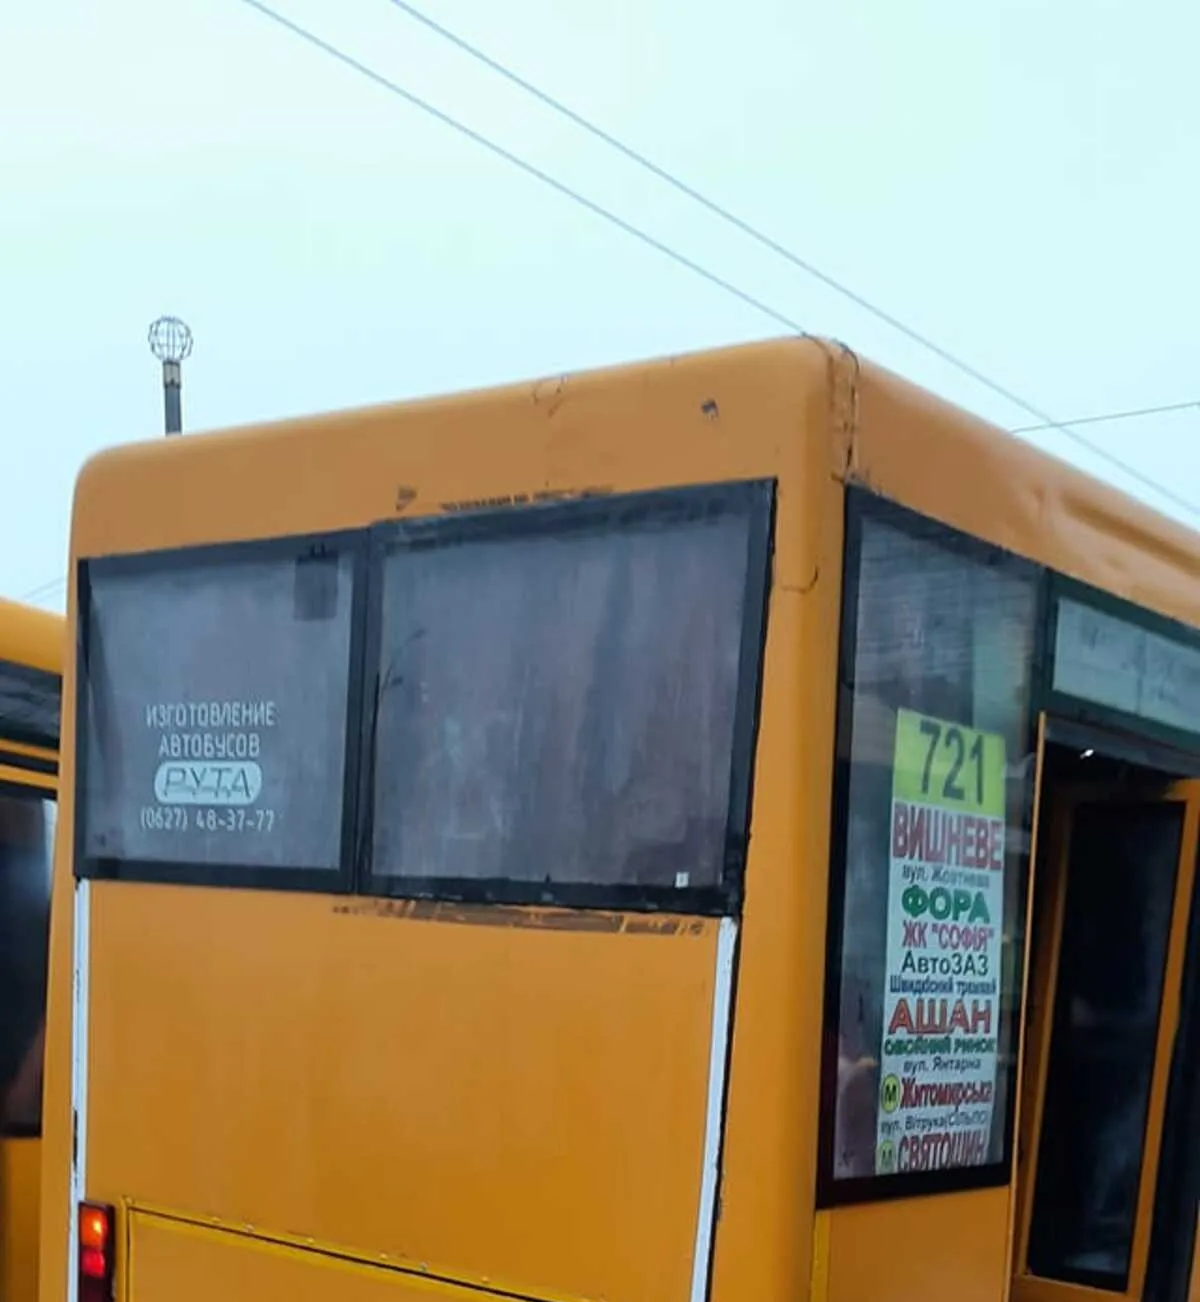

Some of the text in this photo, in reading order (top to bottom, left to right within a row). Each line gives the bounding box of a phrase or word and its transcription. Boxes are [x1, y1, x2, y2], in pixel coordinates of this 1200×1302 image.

[146, 701, 275, 727] ИЗГОТОВЛЕНИЕ
[159, 733, 260, 757] АВТОБУСОВ
[920, 718, 984, 805] 721
[164, 767, 251, 798] РУТА
[141, 807, 275, 832] (0627) 48-37-77
[893, 802, 1002, 871] ВИШНЕВЕ
[902, 884, 990, 924] ФОРА
[902, 920, 928, 949] ЖК
[902, 950, 989, 976] АвтоЗАЗ
[888, 998, 992, 1034] АШАН
